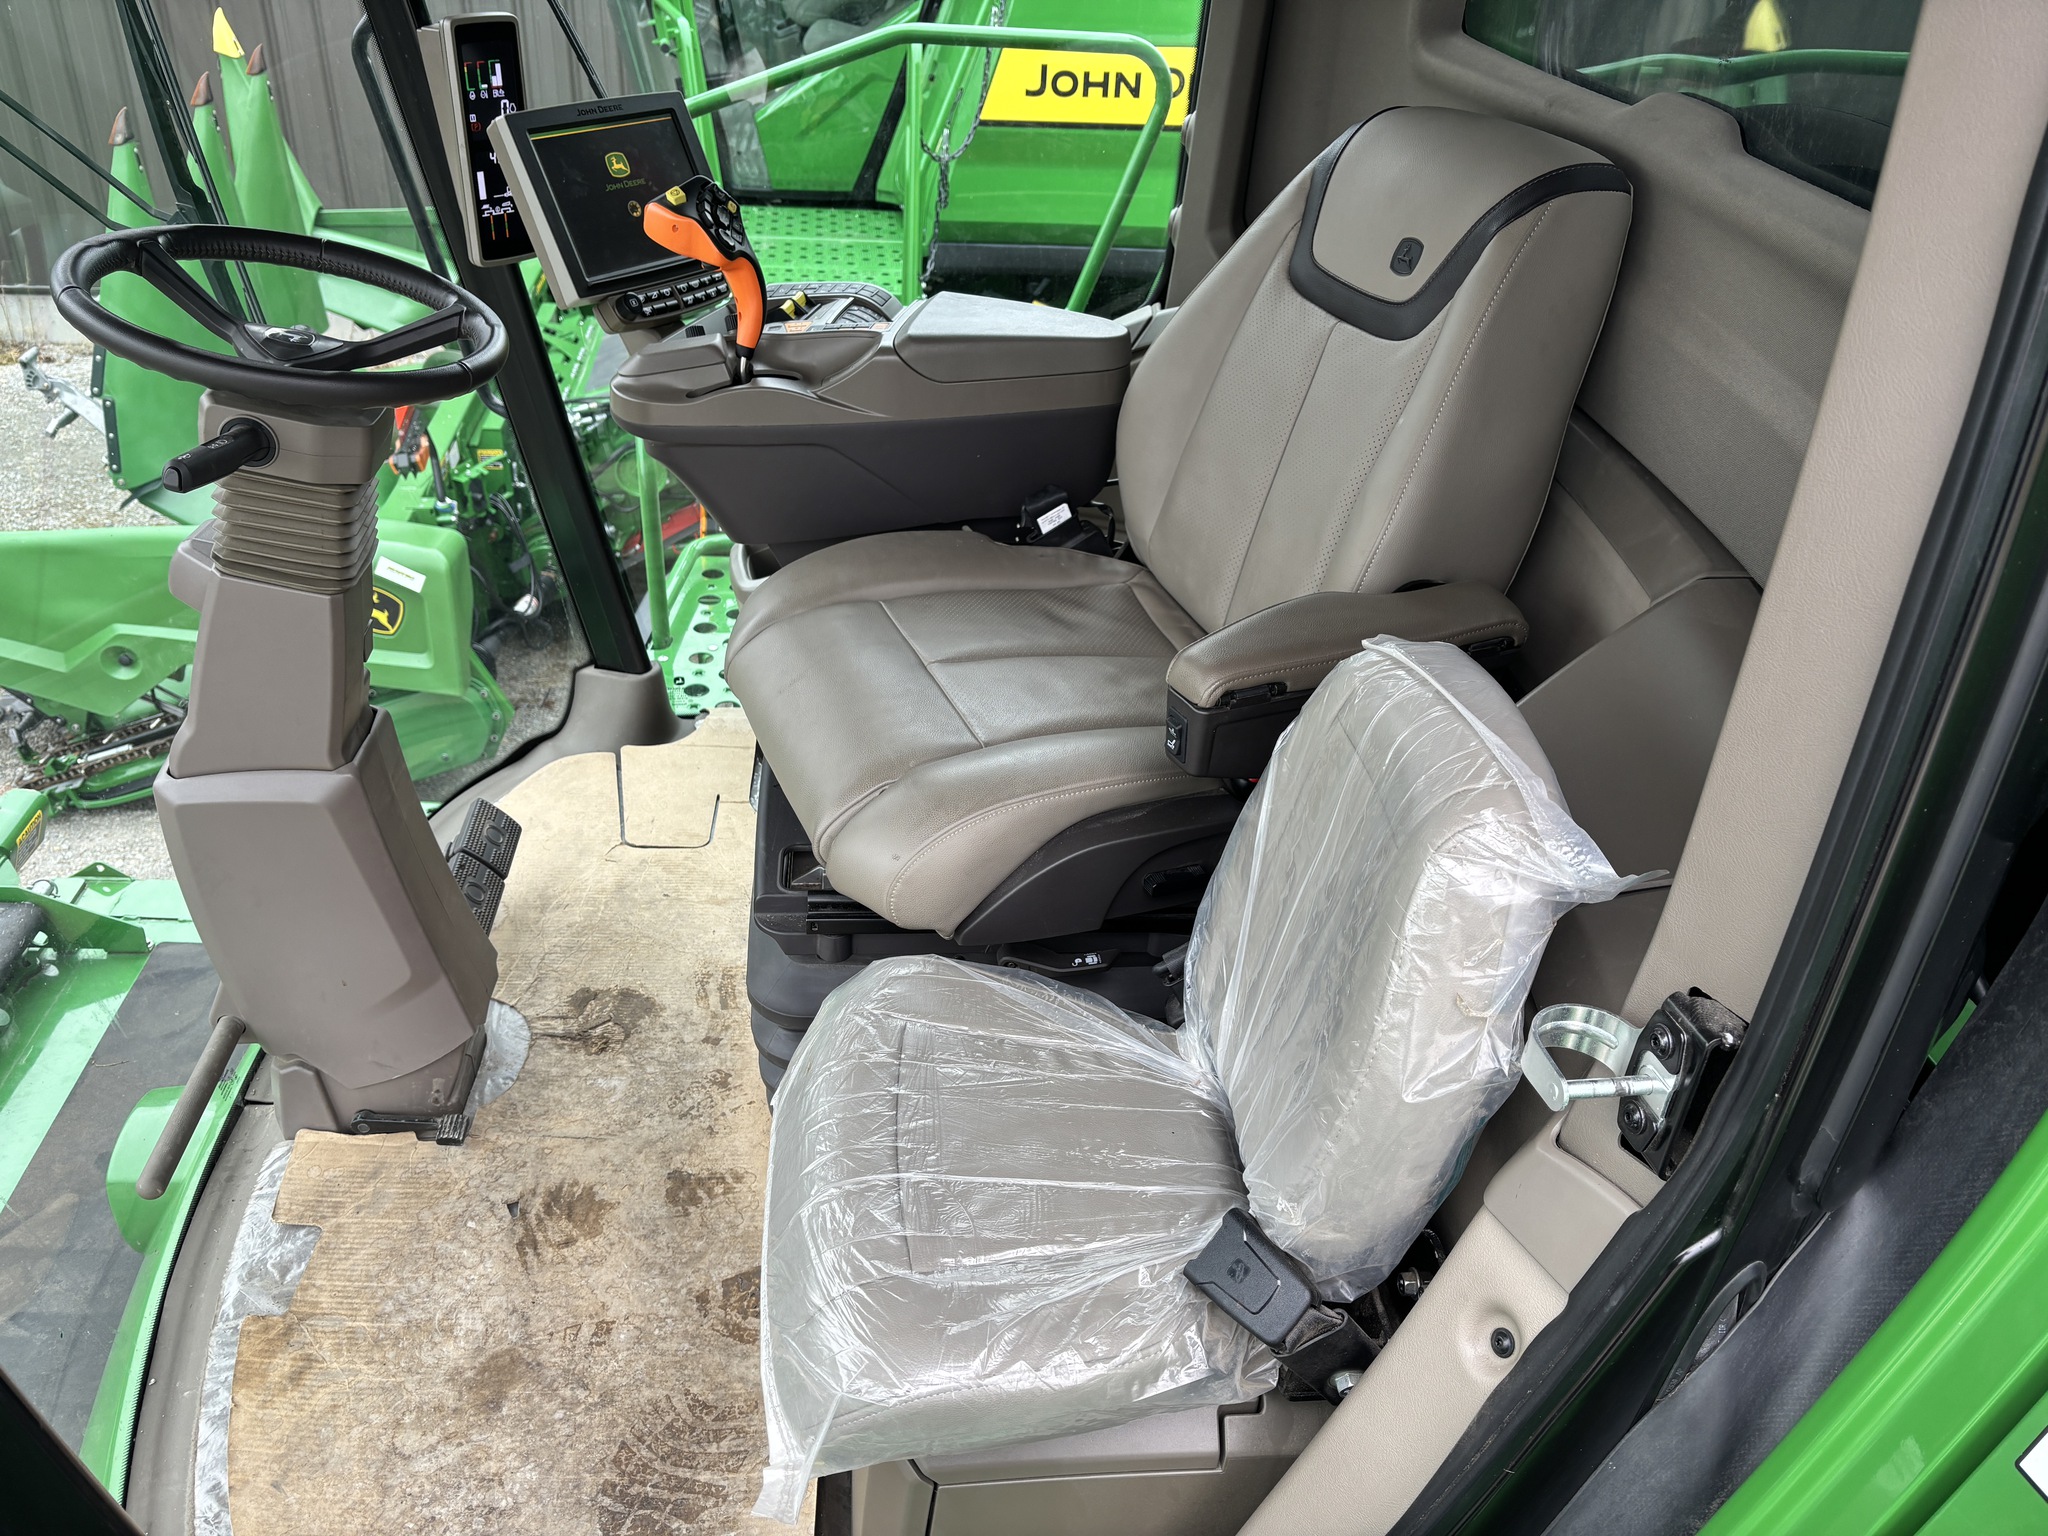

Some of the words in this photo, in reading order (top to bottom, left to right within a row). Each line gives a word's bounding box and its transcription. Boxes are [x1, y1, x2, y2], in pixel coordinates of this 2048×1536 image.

[1026, 64, 1141, 98] JOHN
[577, 108, 597, 117] JOHN
[597, 104, 624, 114] DEERE
[605, 181, 623, 192] JOHN
[623, 178, 646, 188] DEERE
[21, 811, 42, 841] CAUTION
